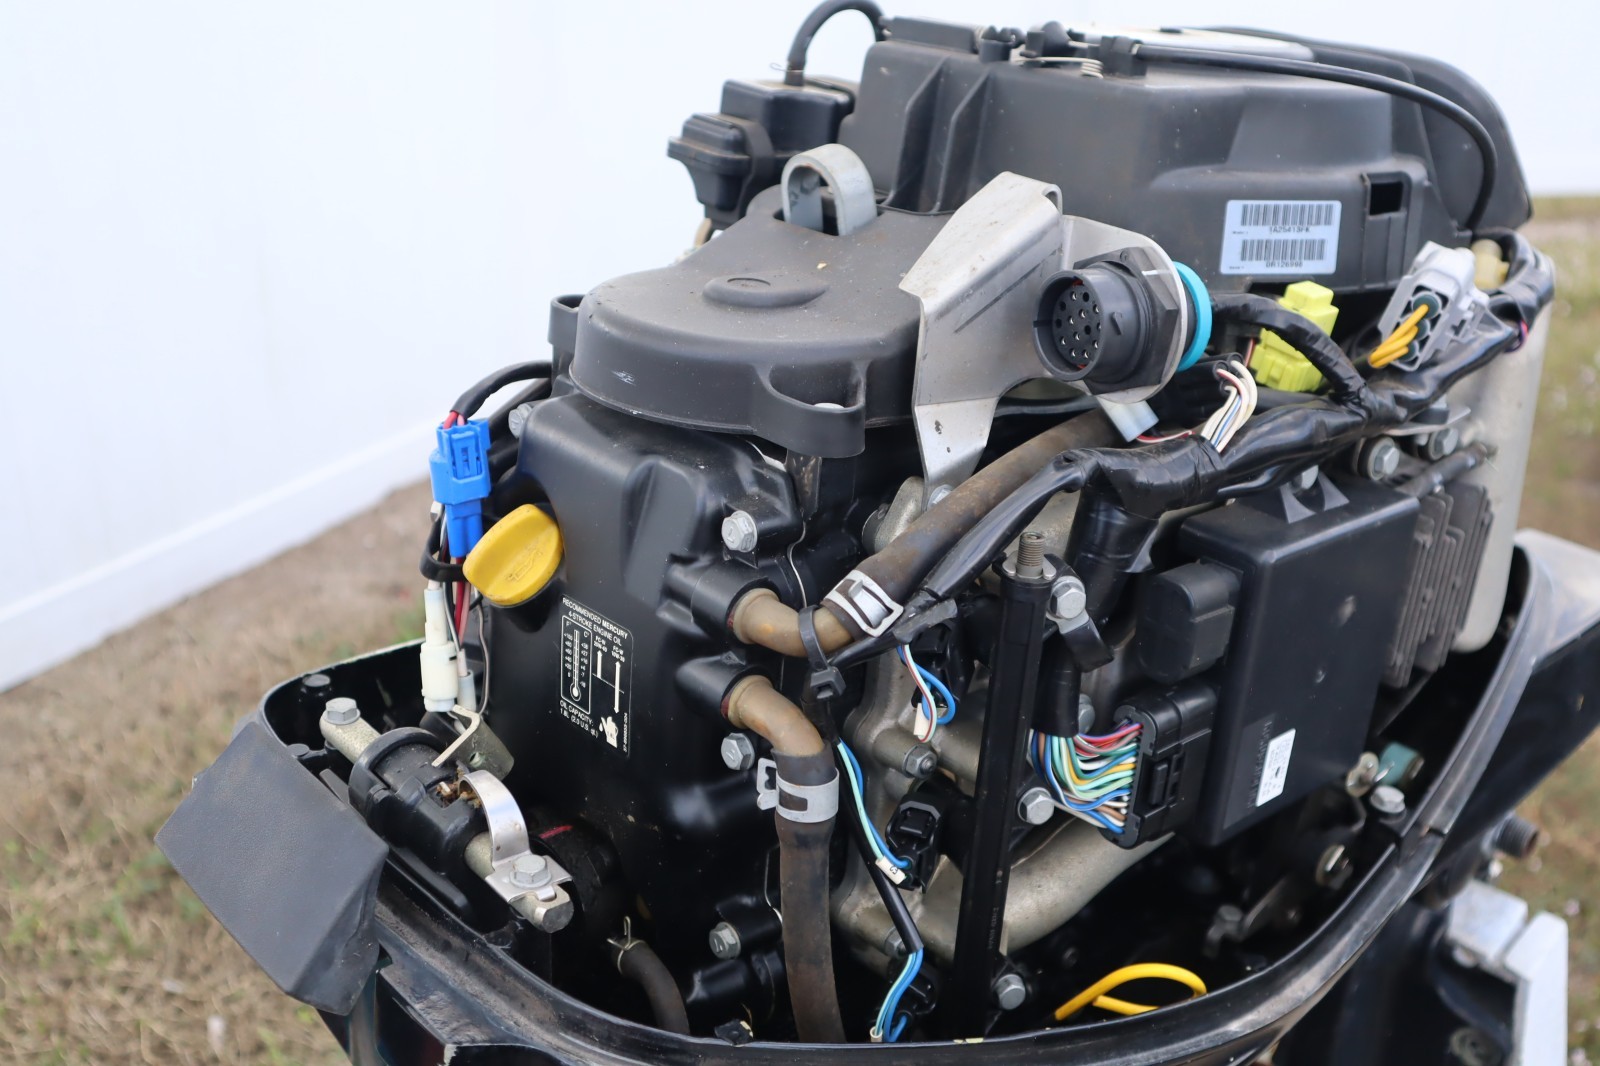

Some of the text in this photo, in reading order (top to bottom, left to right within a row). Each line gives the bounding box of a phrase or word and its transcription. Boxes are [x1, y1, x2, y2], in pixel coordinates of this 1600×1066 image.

[562, 598, 628, 640] RECOMMENDED MERCURY
[568, 611, 622, 646] 4-STROKE ENGINE OIL
[560, 700, 594, 726] OIL CAPACITY:
